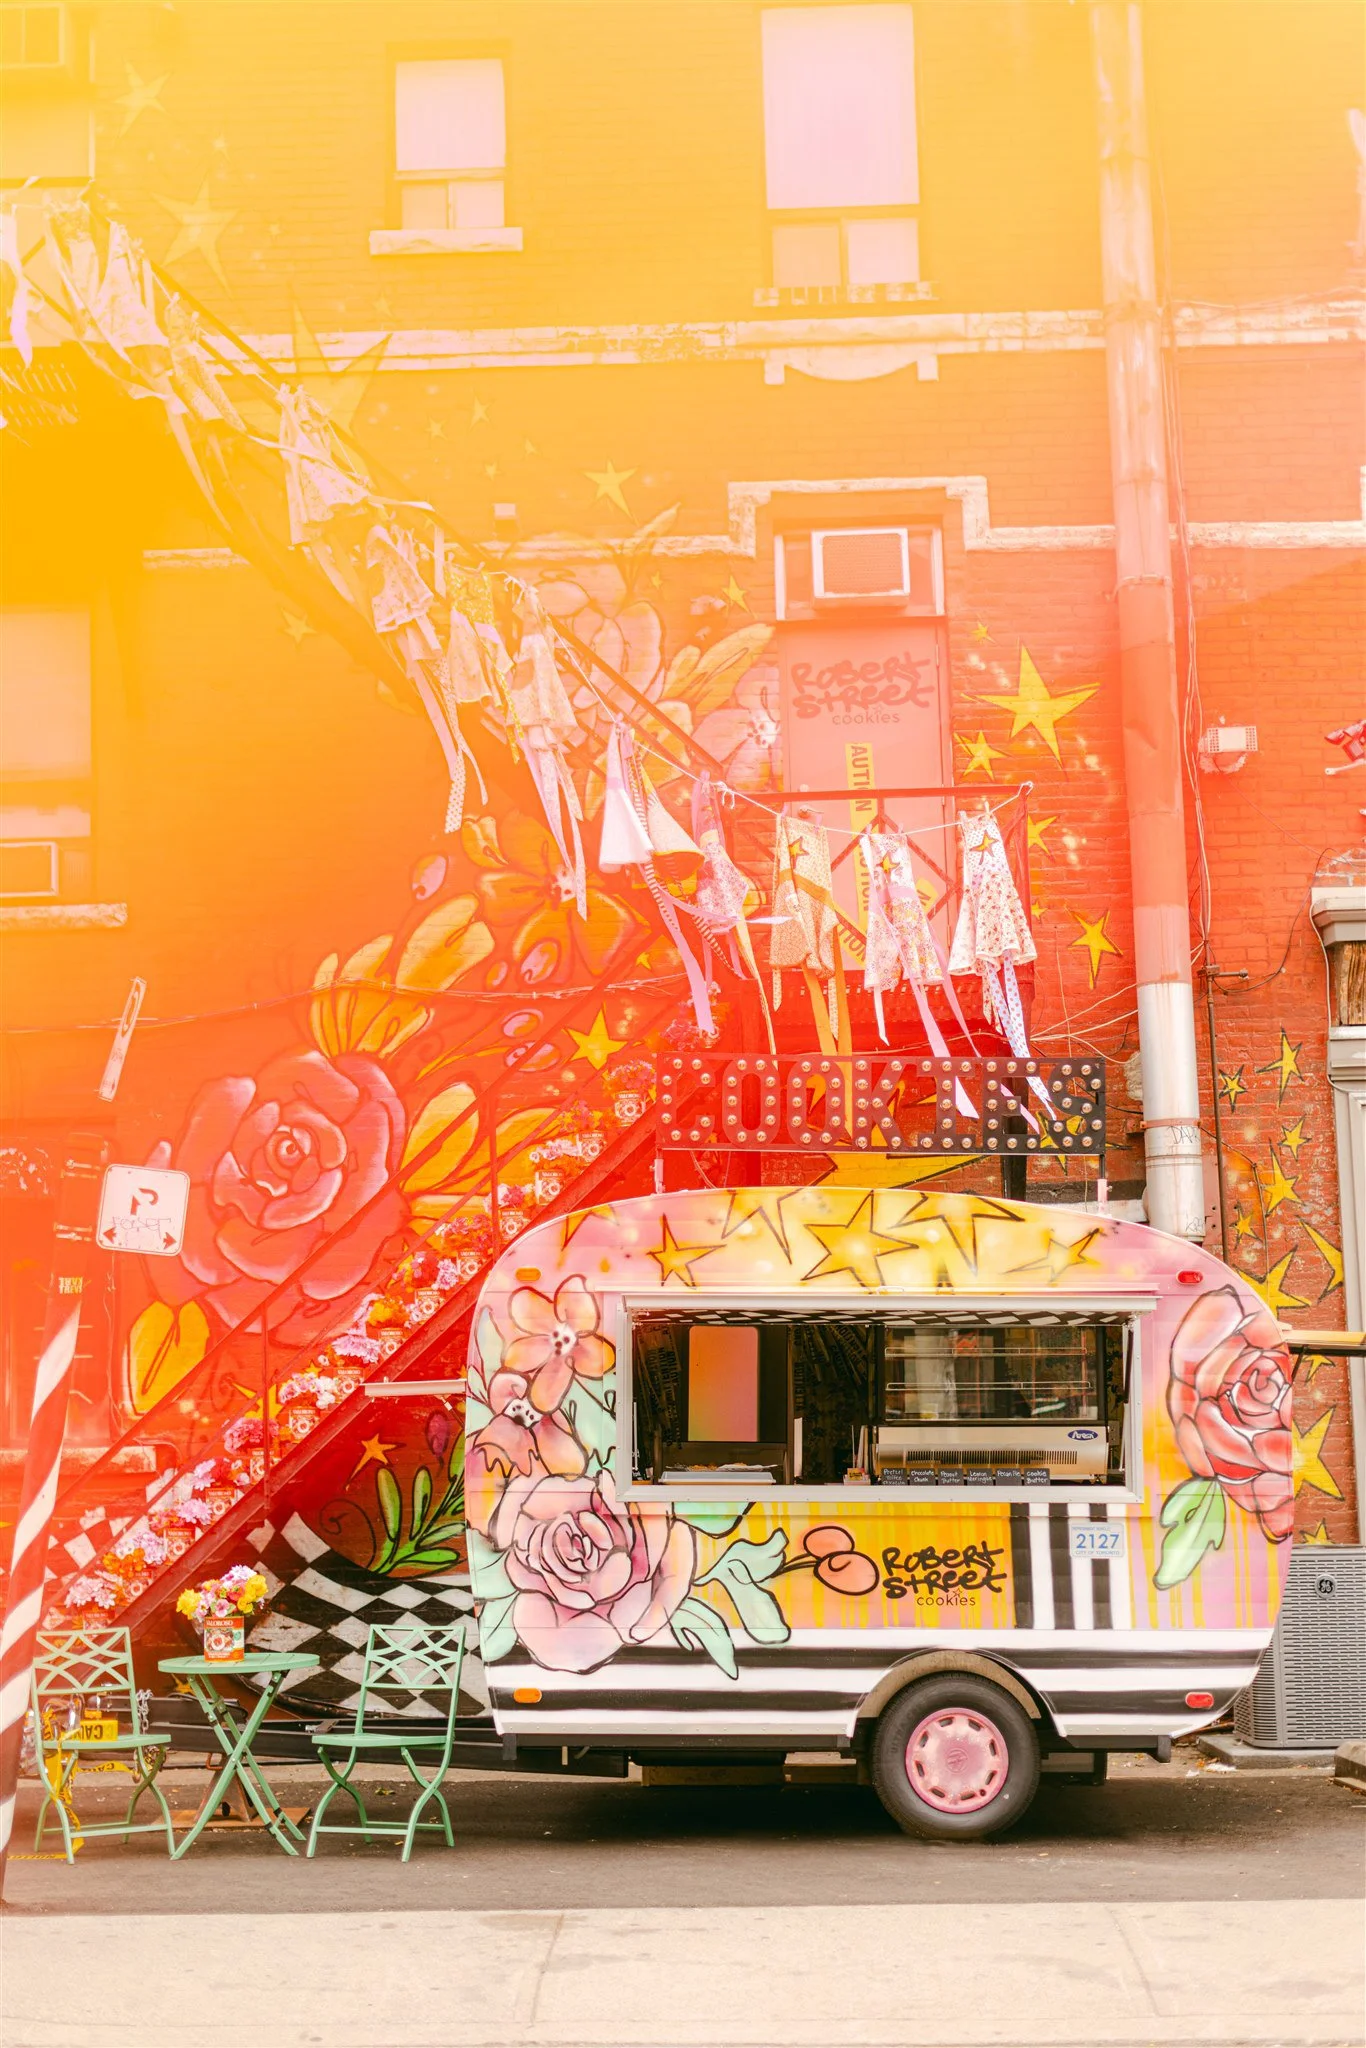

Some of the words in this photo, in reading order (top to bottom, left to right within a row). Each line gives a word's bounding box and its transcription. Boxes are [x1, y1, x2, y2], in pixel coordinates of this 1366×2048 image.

[832, 704, 900, 725] cookies
[656, 1055, 1103, 1153] COOKIES
[1076, 1533, 1119, 1549] 2127
[917, 1590, 975, 1607] cookies
